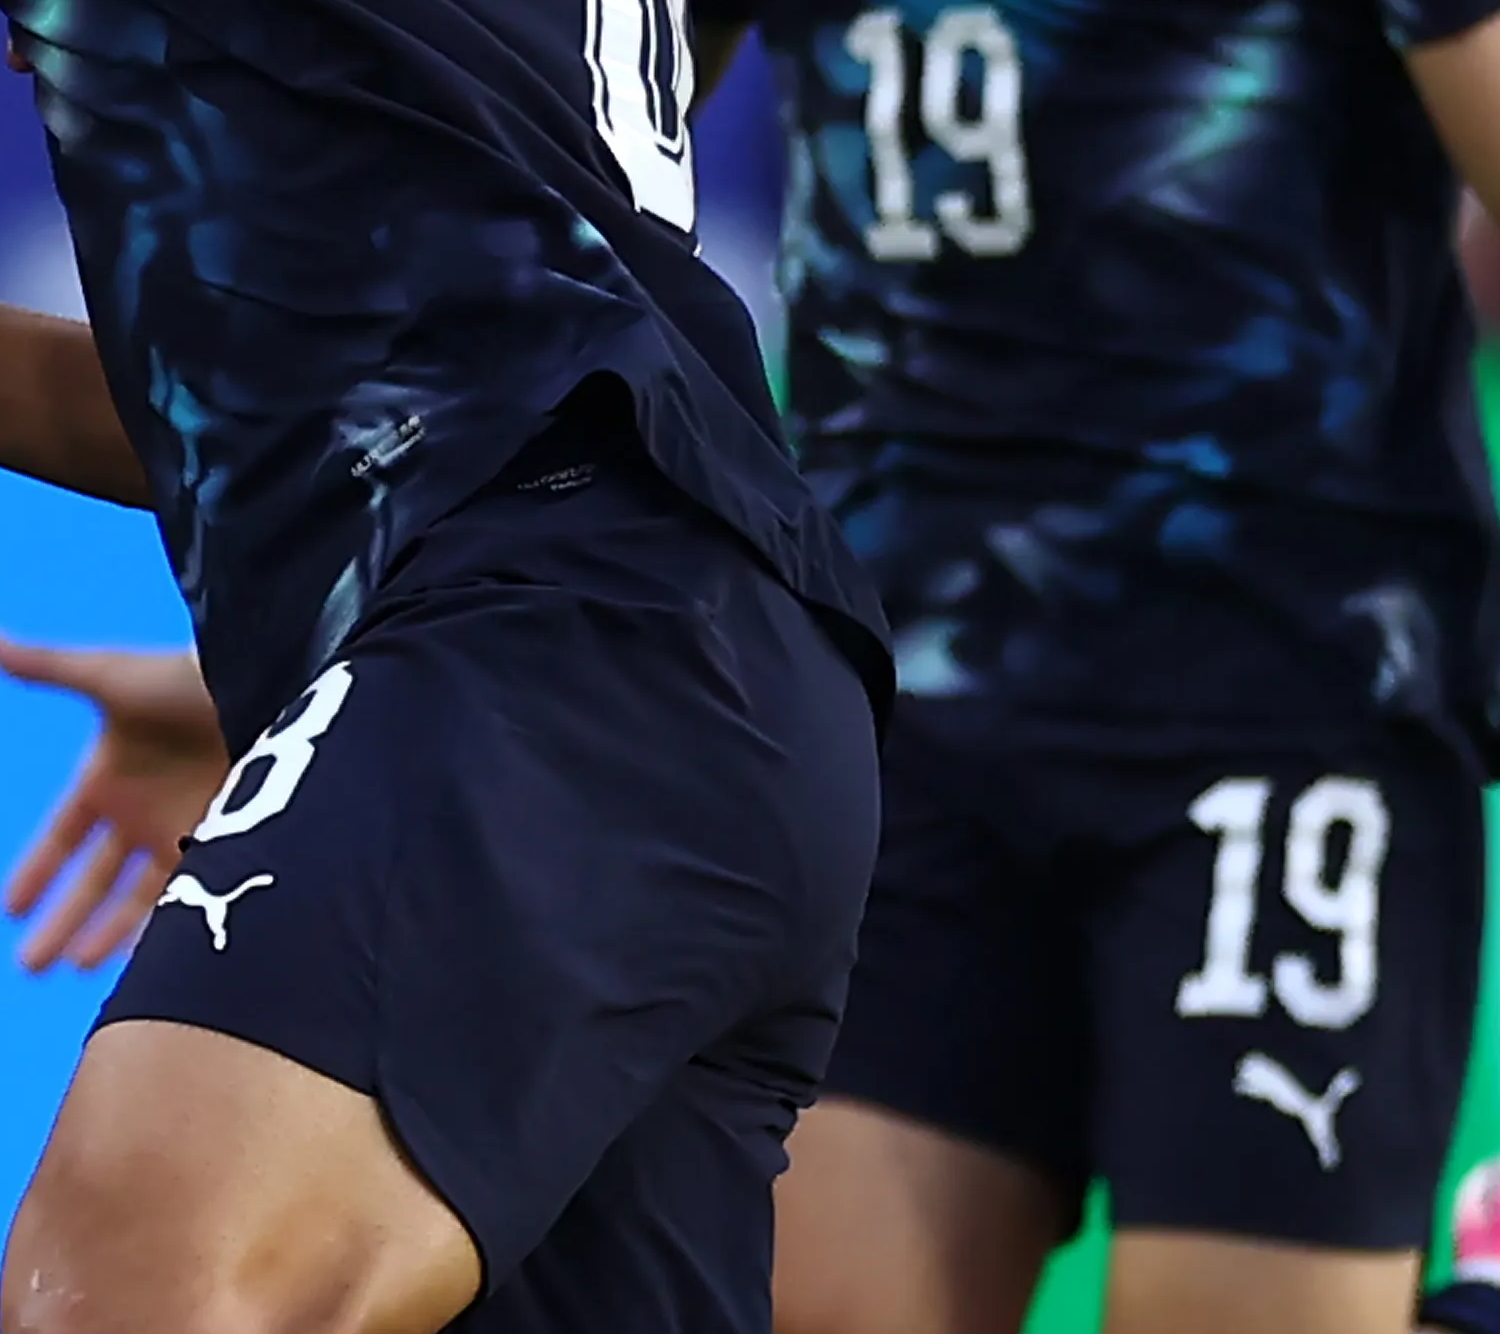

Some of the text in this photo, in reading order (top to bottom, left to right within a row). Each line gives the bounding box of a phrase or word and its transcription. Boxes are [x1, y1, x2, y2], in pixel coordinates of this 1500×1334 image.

[843, 4, 1033, 263] 19
[193, 660, 354, 843] 8
[1174, 774, 1392, 1031] 19
